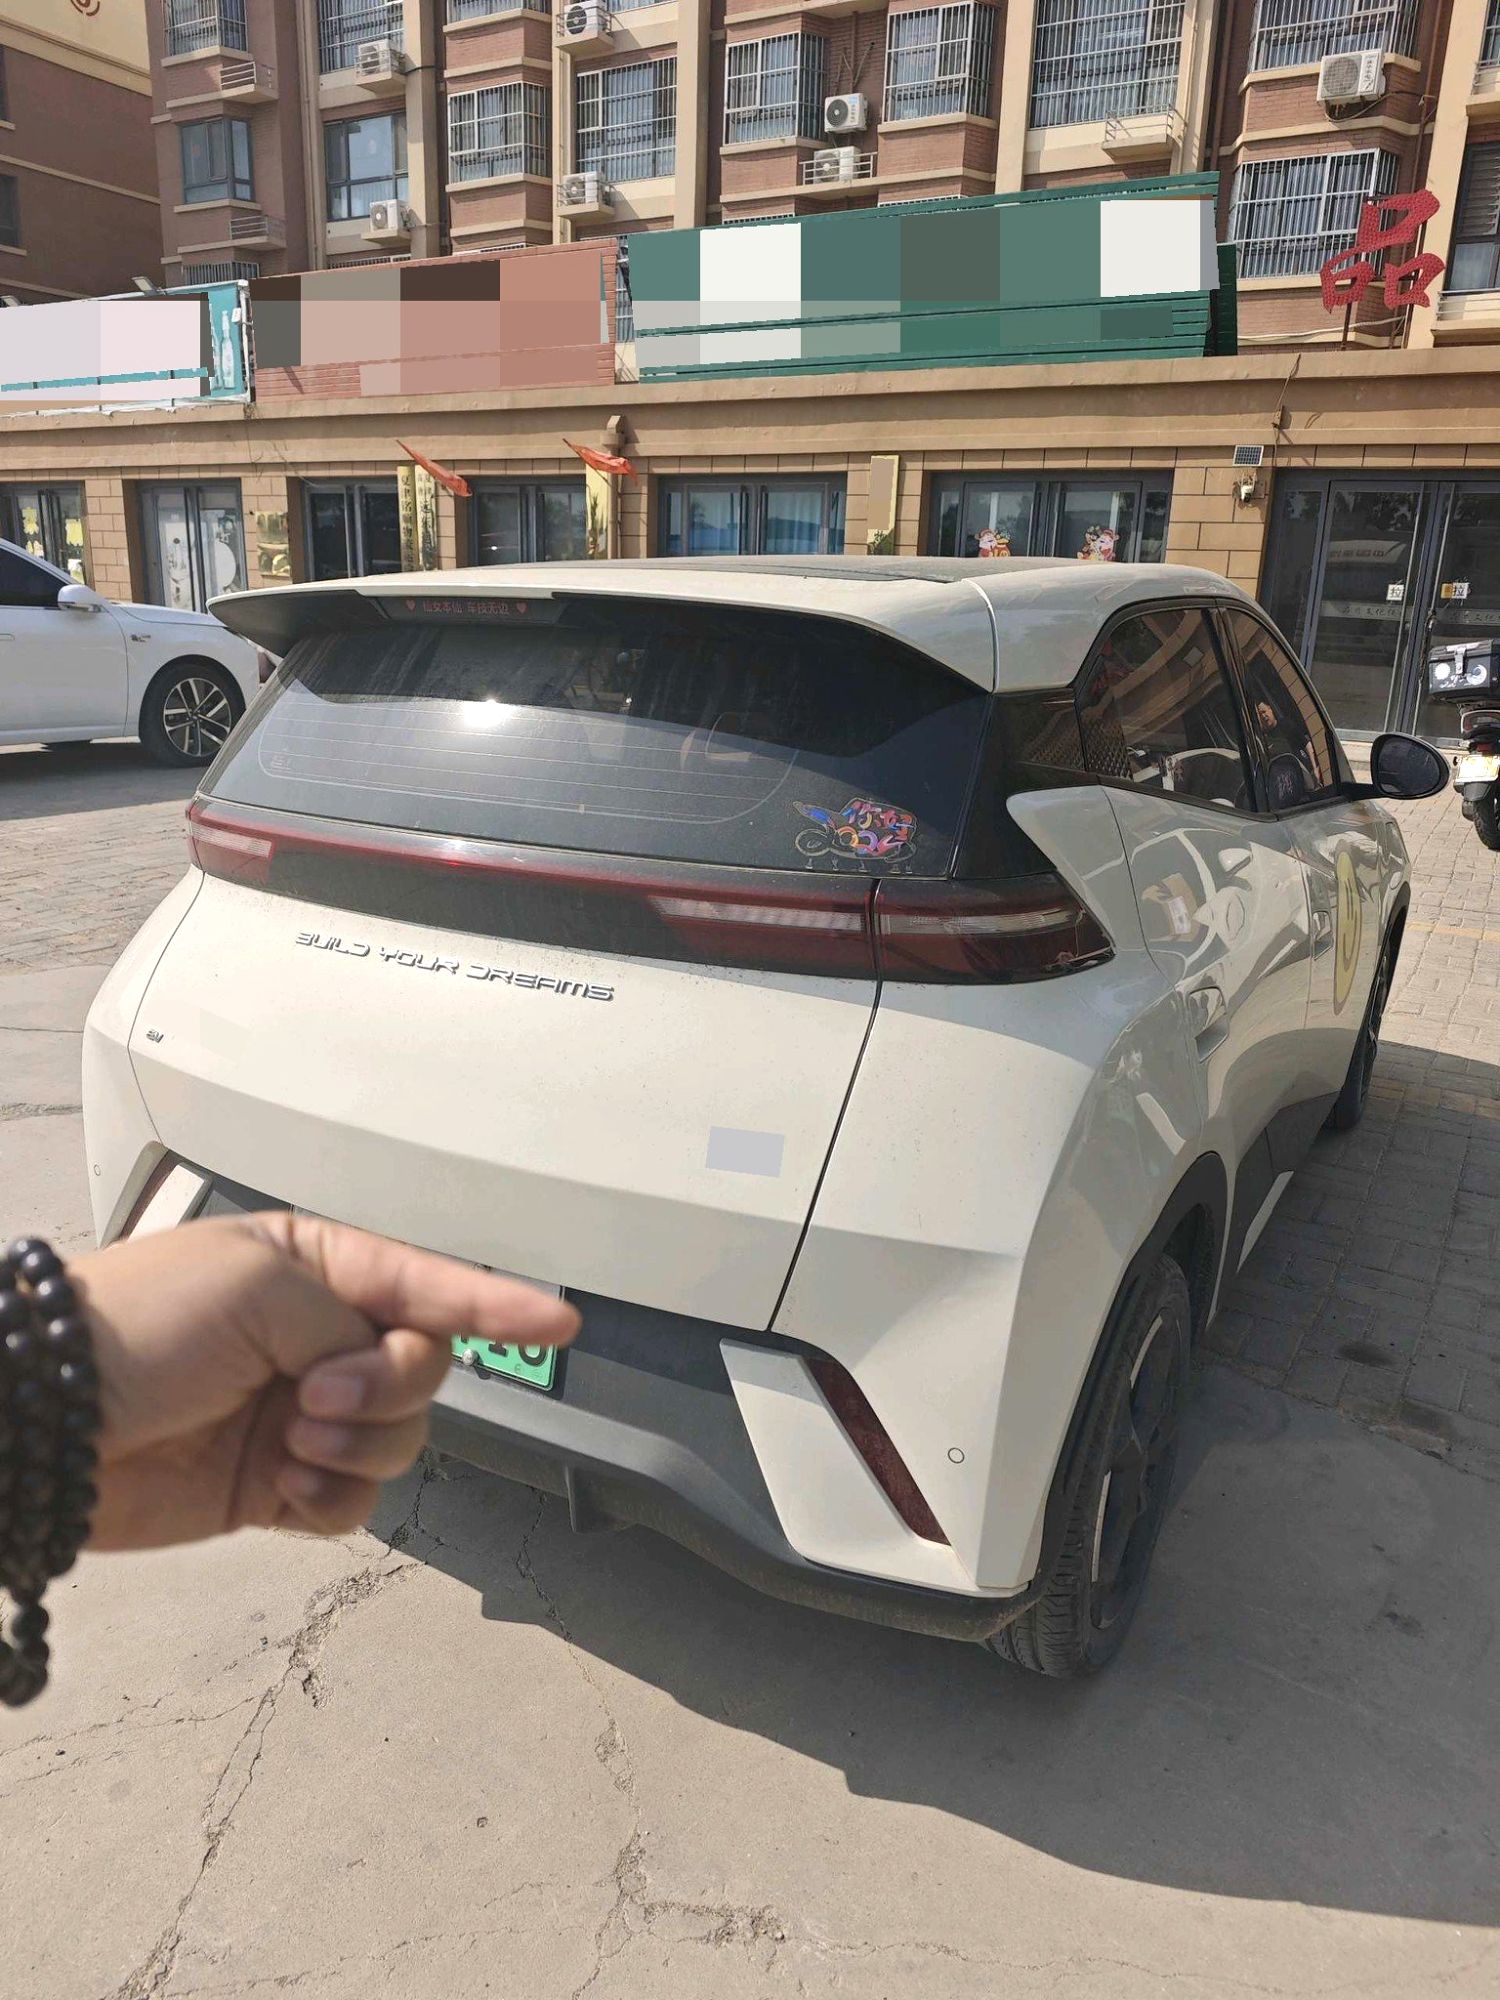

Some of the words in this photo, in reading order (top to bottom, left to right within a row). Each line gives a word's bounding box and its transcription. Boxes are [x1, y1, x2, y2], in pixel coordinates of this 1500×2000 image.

[1320, 189, 1445, 314] 品
[422, 601, 463, 613] 仙女本仙
[467, 602, 510, 615] 车技无边
[295, 932, 370, 957] BUILD
[379, 945, 459, 975] YOUR
[466, 964, 615, 1001] DREAMS
